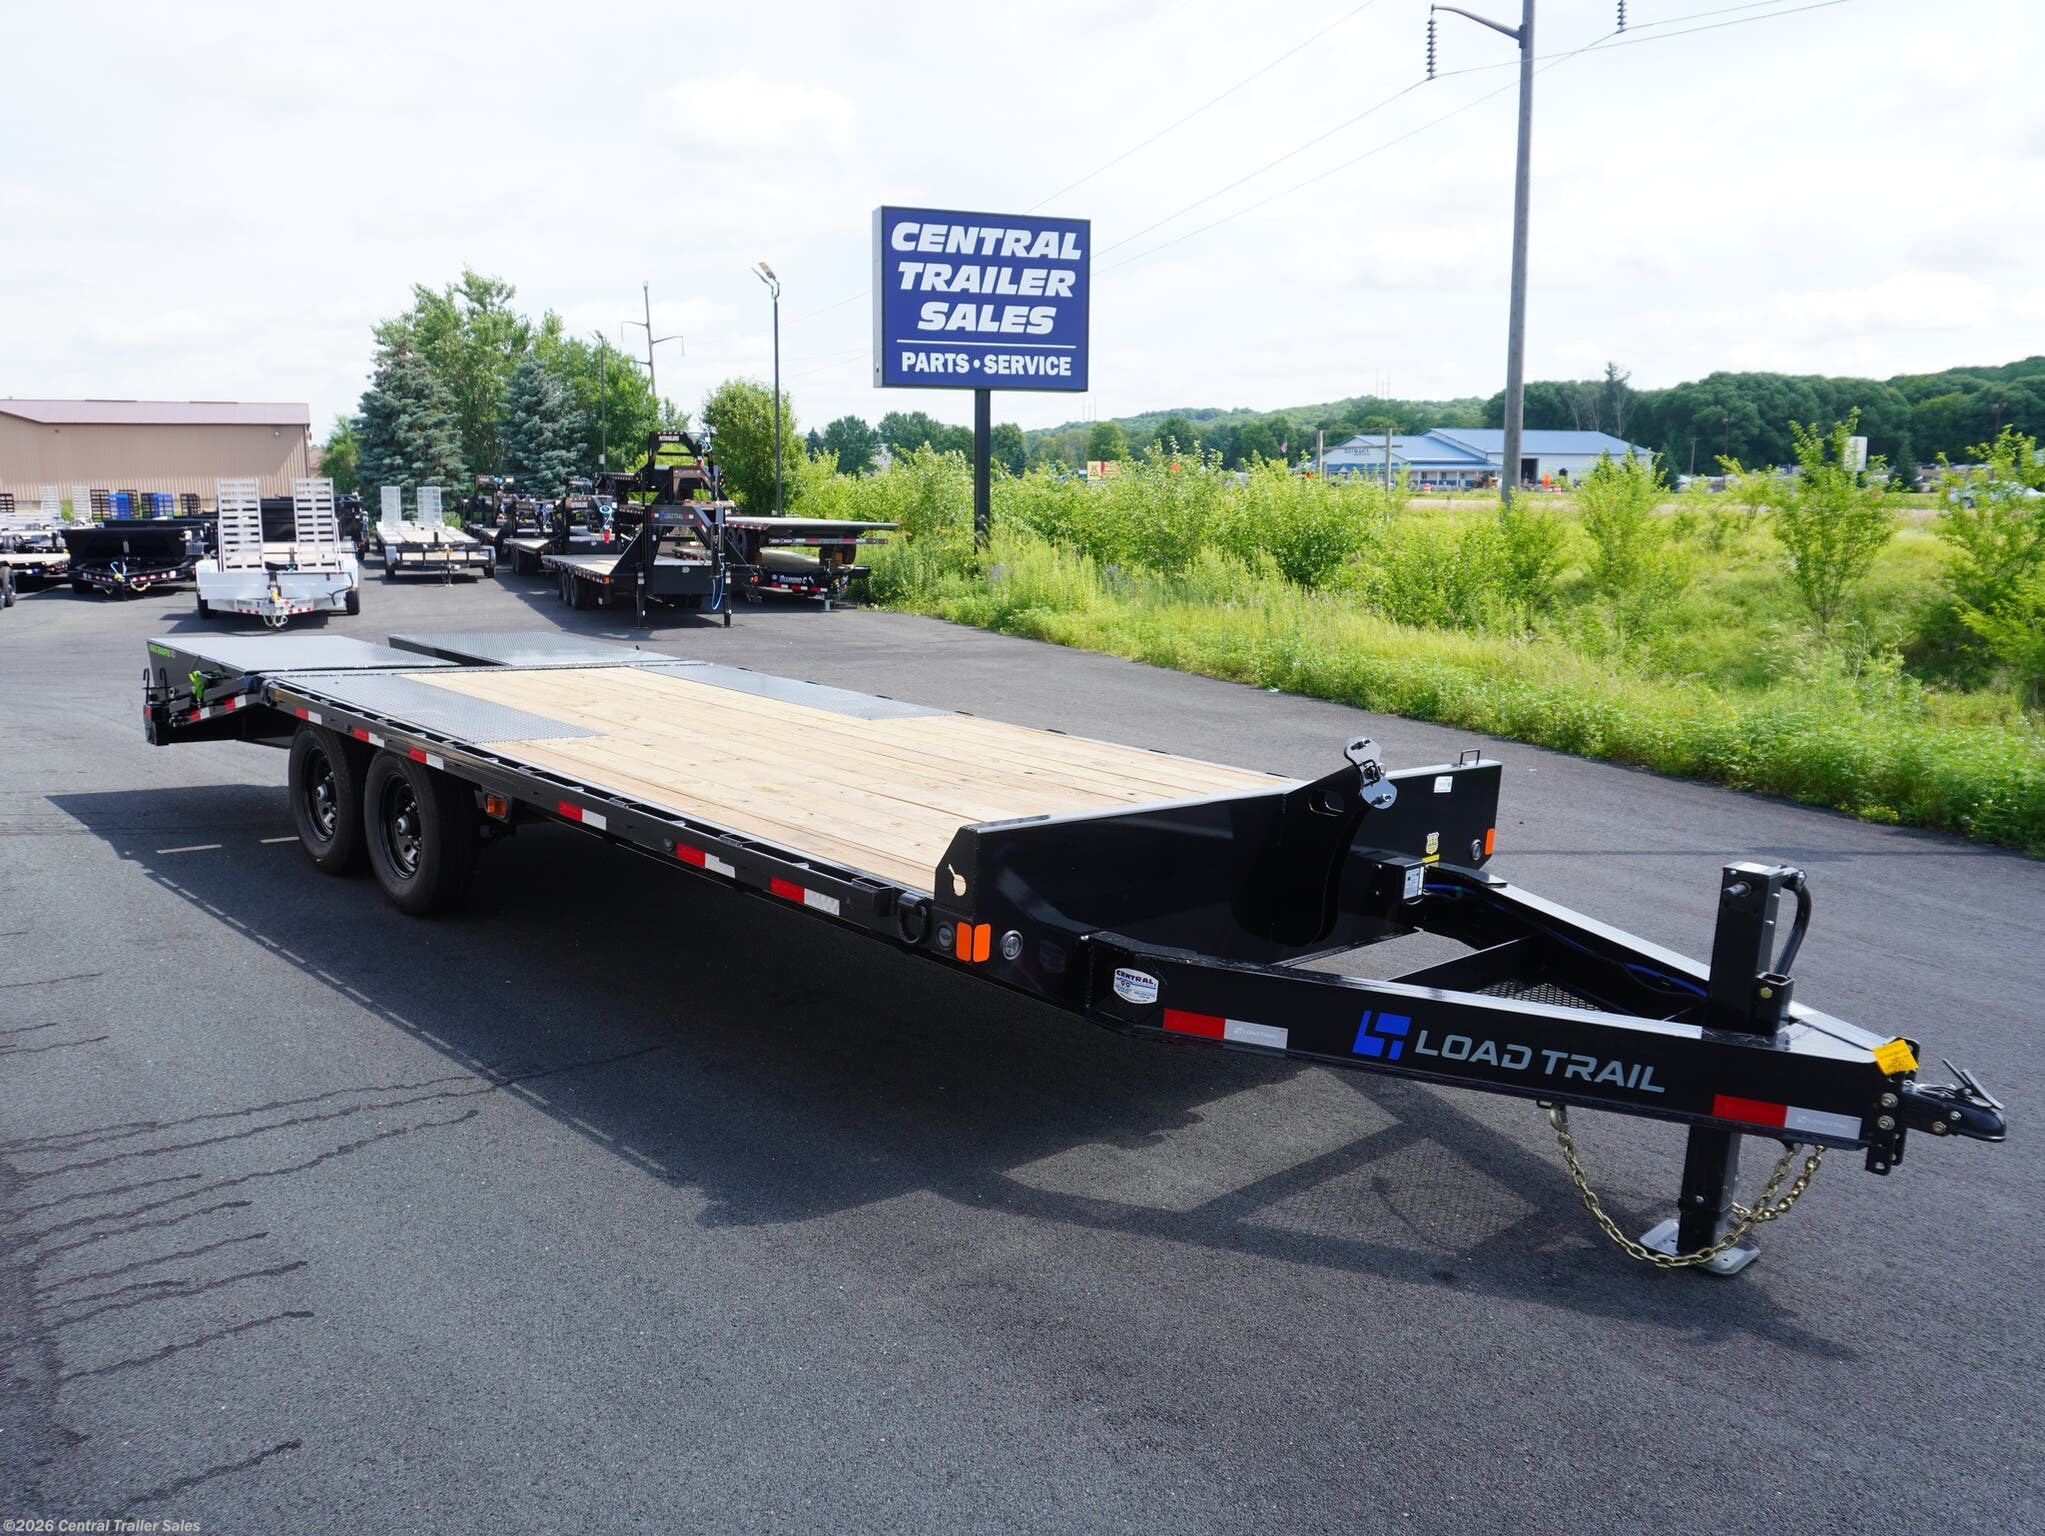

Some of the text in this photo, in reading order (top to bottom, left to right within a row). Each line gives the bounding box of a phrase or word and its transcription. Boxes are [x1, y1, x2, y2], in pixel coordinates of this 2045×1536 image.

[891, 221, 1082, 260] CENTRAL
[898, 261, 1076, 297] TRAILER
[917, 301, 1057, 335] SALES
[902, 351, 1072, 376] PARTS SERVICE
[1116, 970, 1154, 985] CENTRAL
[1415, 1030, 1665, 1093] LOAD TRAIL
